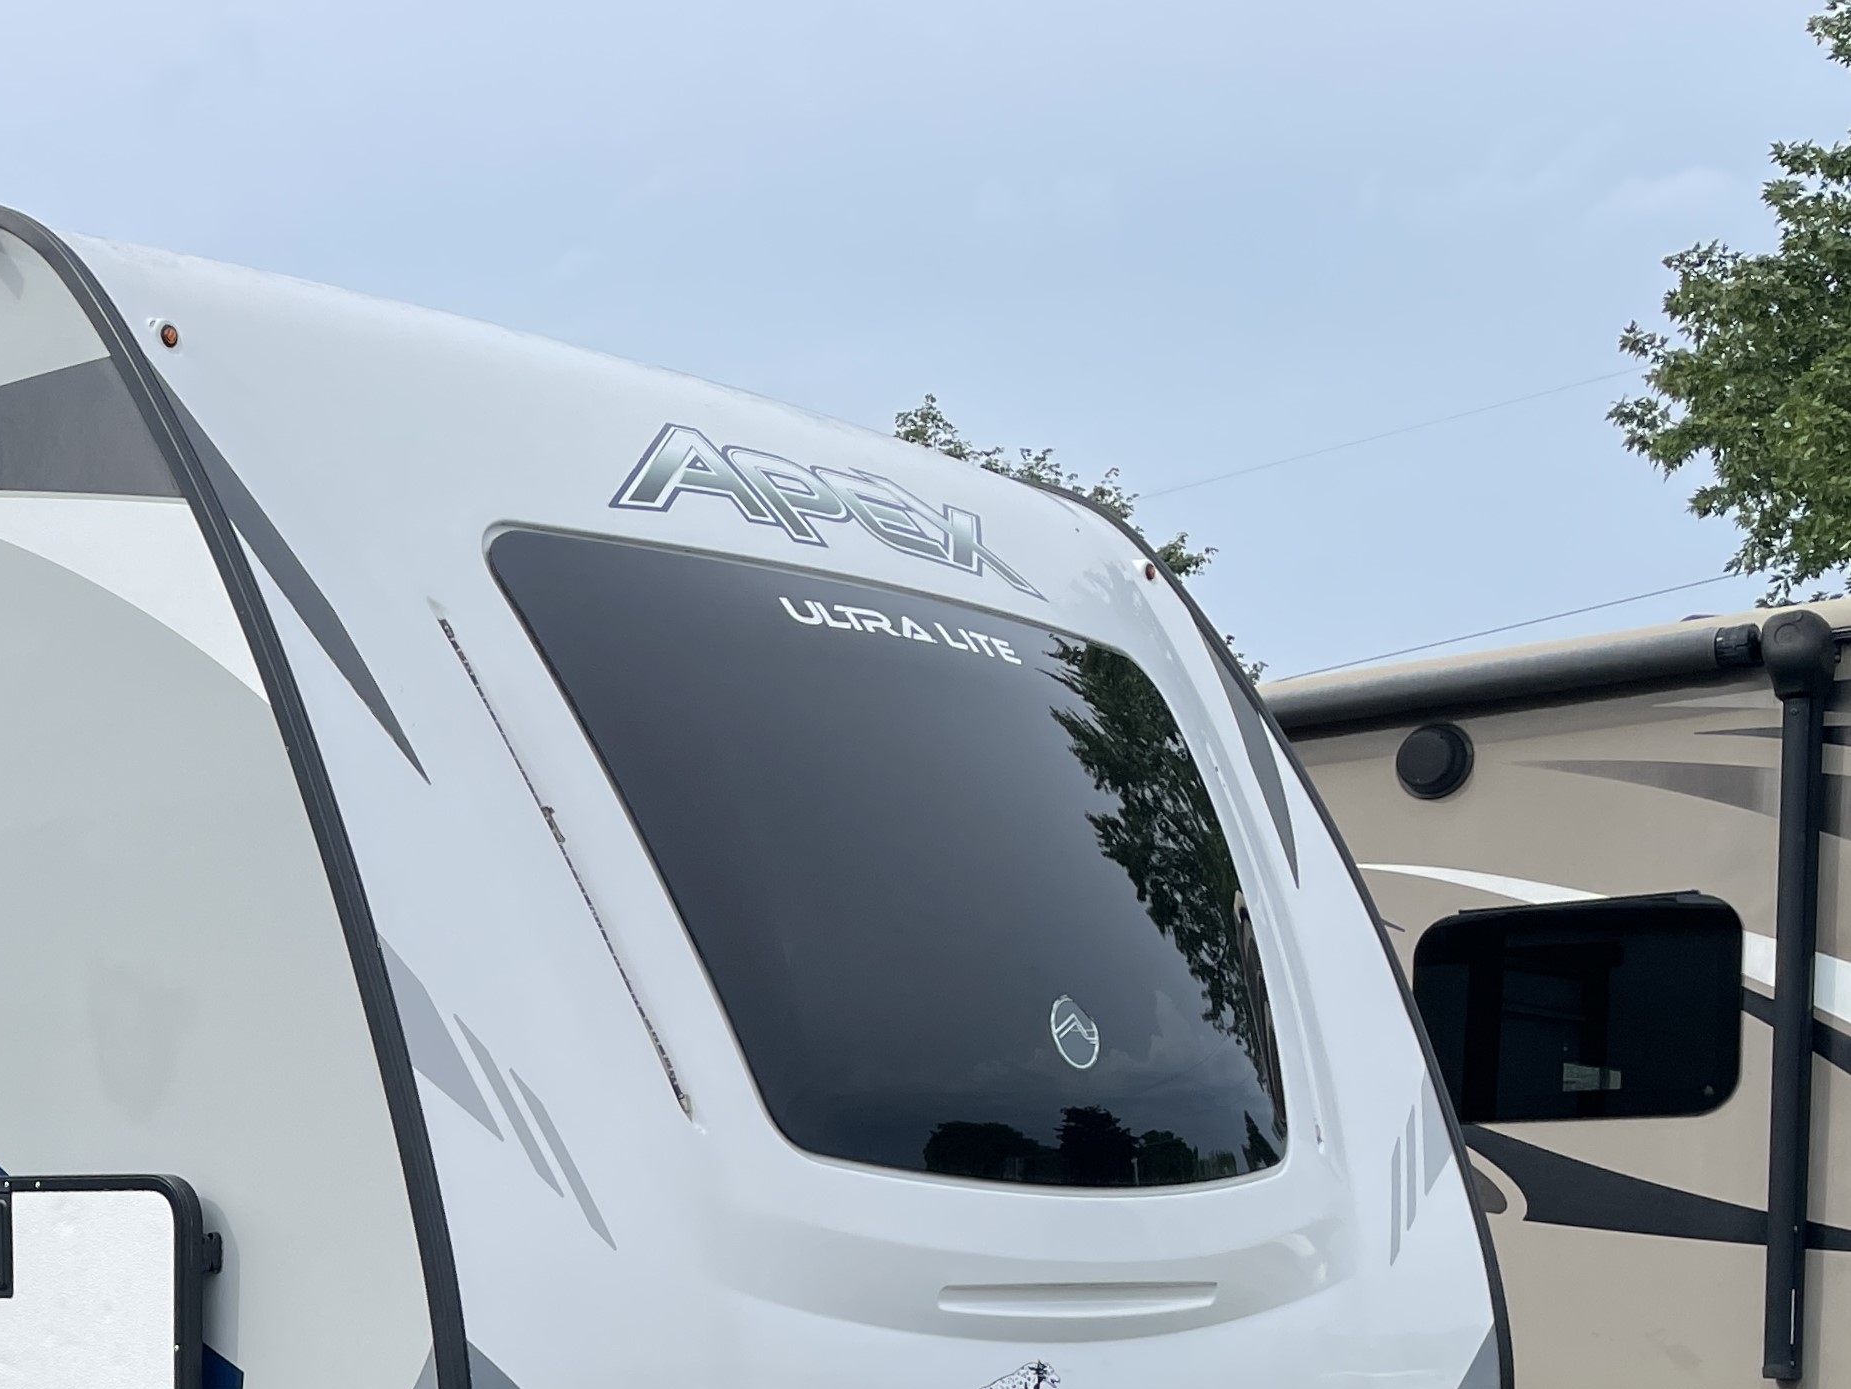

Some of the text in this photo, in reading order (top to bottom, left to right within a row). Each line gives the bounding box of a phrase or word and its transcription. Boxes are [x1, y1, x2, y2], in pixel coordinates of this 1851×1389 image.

[609, 423, 1049, 602] APEX
[778, 596, 1023, 666] ULTRA LITE
